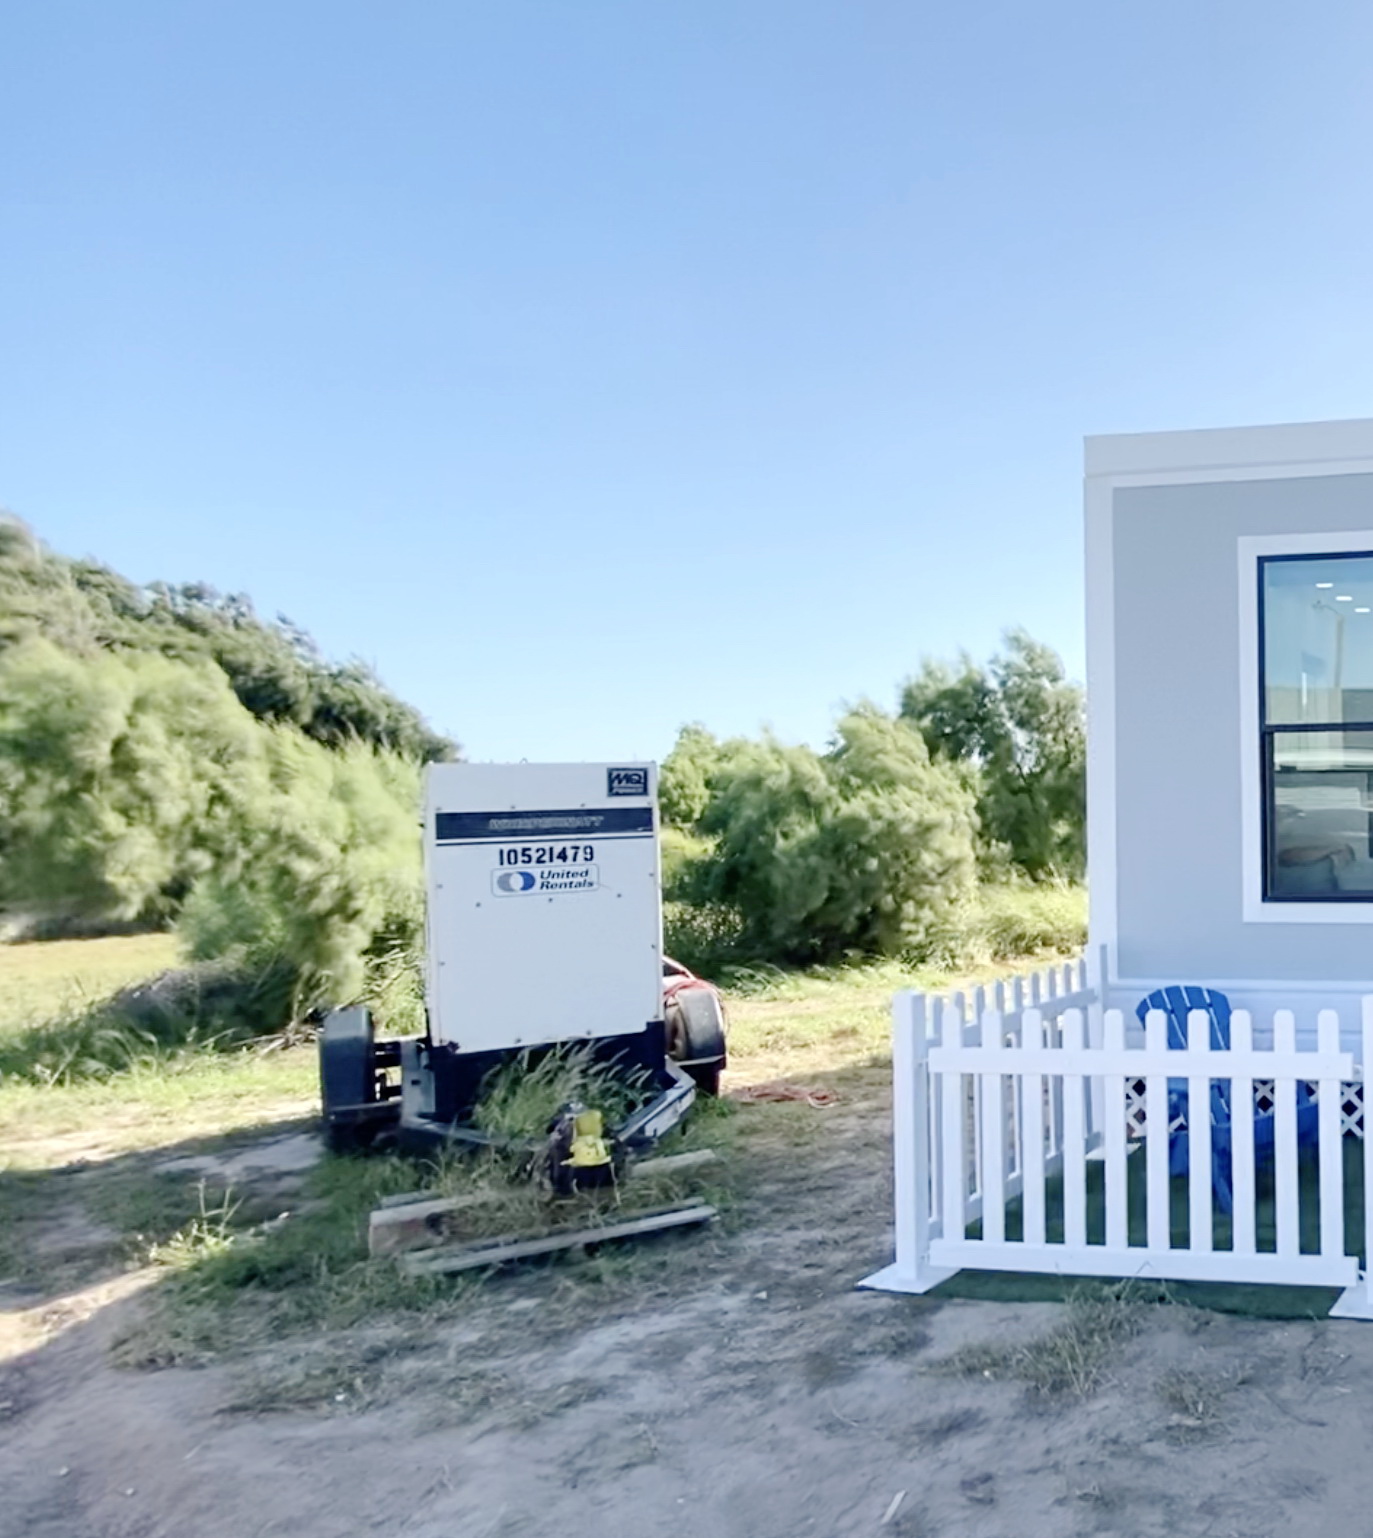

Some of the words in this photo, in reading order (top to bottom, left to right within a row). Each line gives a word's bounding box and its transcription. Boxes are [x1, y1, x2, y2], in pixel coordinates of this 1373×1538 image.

[611, 772, 644, 785] MQ
[499, 845, 594, 866] 10521479
[540, 869, 589, 880] United
[539, 879, 595, 891] Rentals
